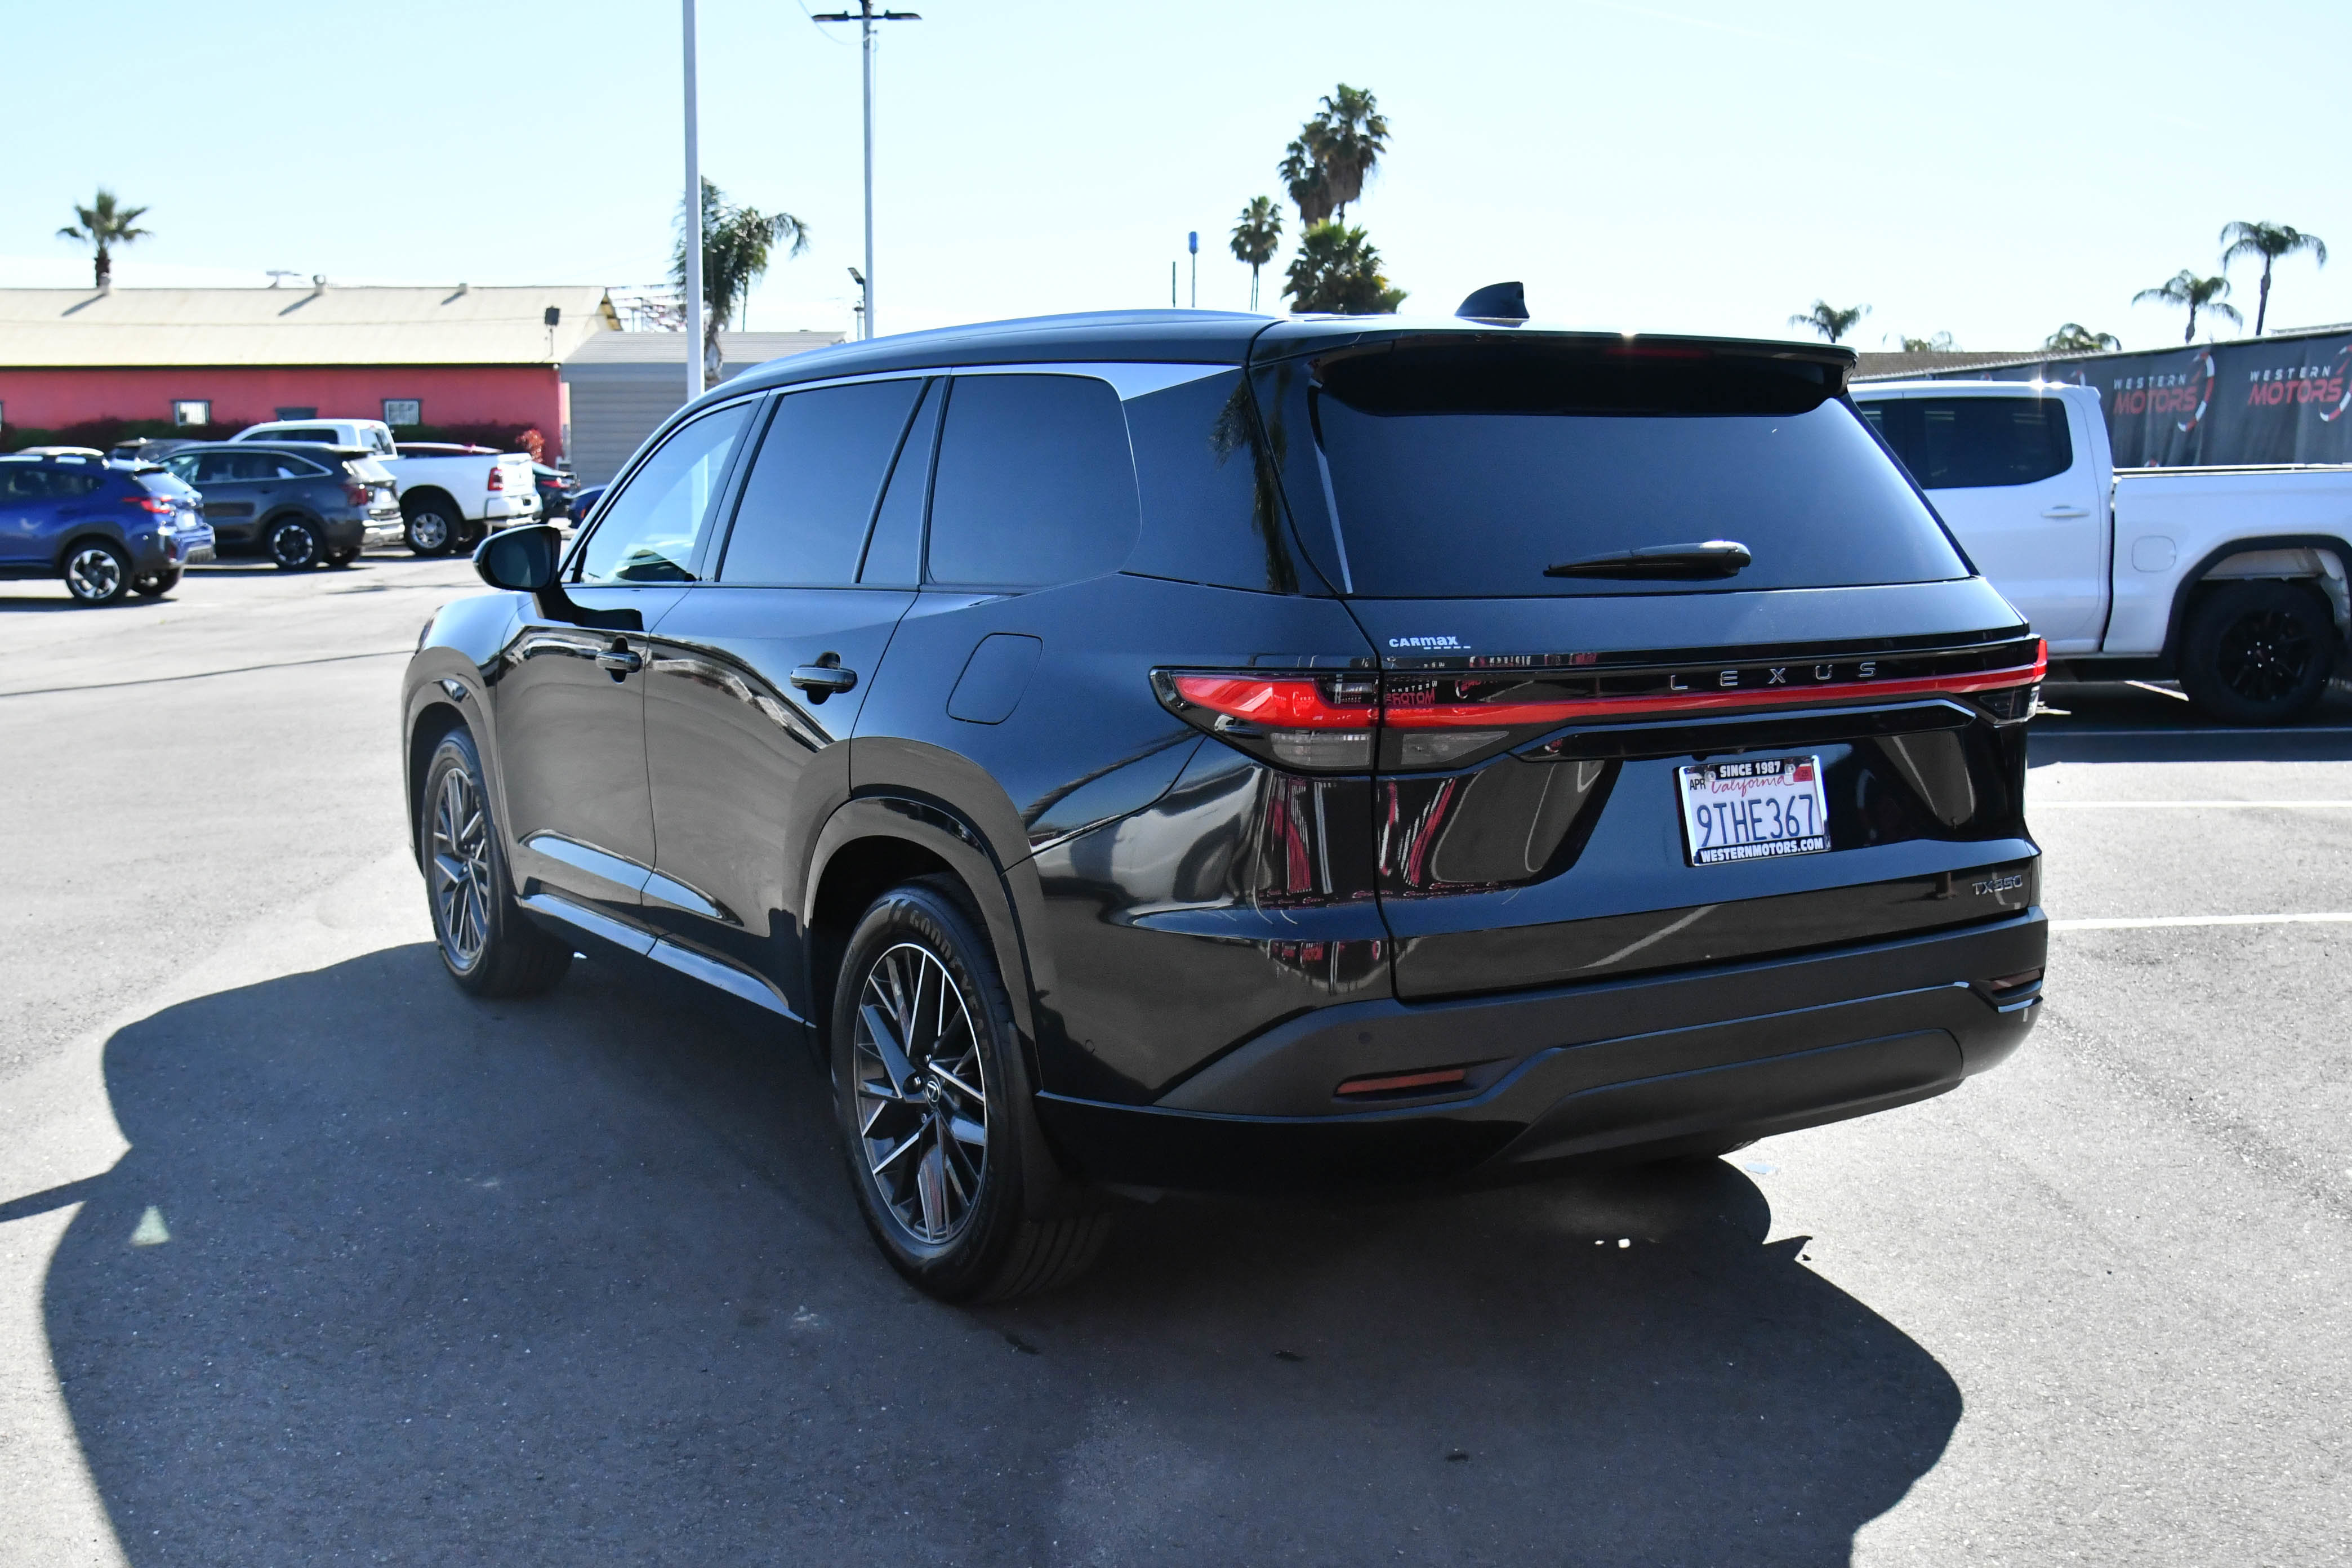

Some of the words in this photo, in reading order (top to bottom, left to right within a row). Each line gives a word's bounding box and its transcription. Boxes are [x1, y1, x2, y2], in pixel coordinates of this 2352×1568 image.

[2114, 374, 2186, 390] WESTERN
[2250, 366, 2330, 382] WESTERN
[2113, 386, 2197, 415] MOTORS
[2248, 377, 2343, 406] MOTORS
[1671, 662, 1877, 691] LEXUS
[1720, 764, 1752, 778] SINCE
[1755, 760, 1780, 774] 1987
[1690, 779, 1705, 791] APR
[1696, 794, 1814, 847] 9THE367
[1700, 838, 1823, 863] WESTERNMOTORS.COM
